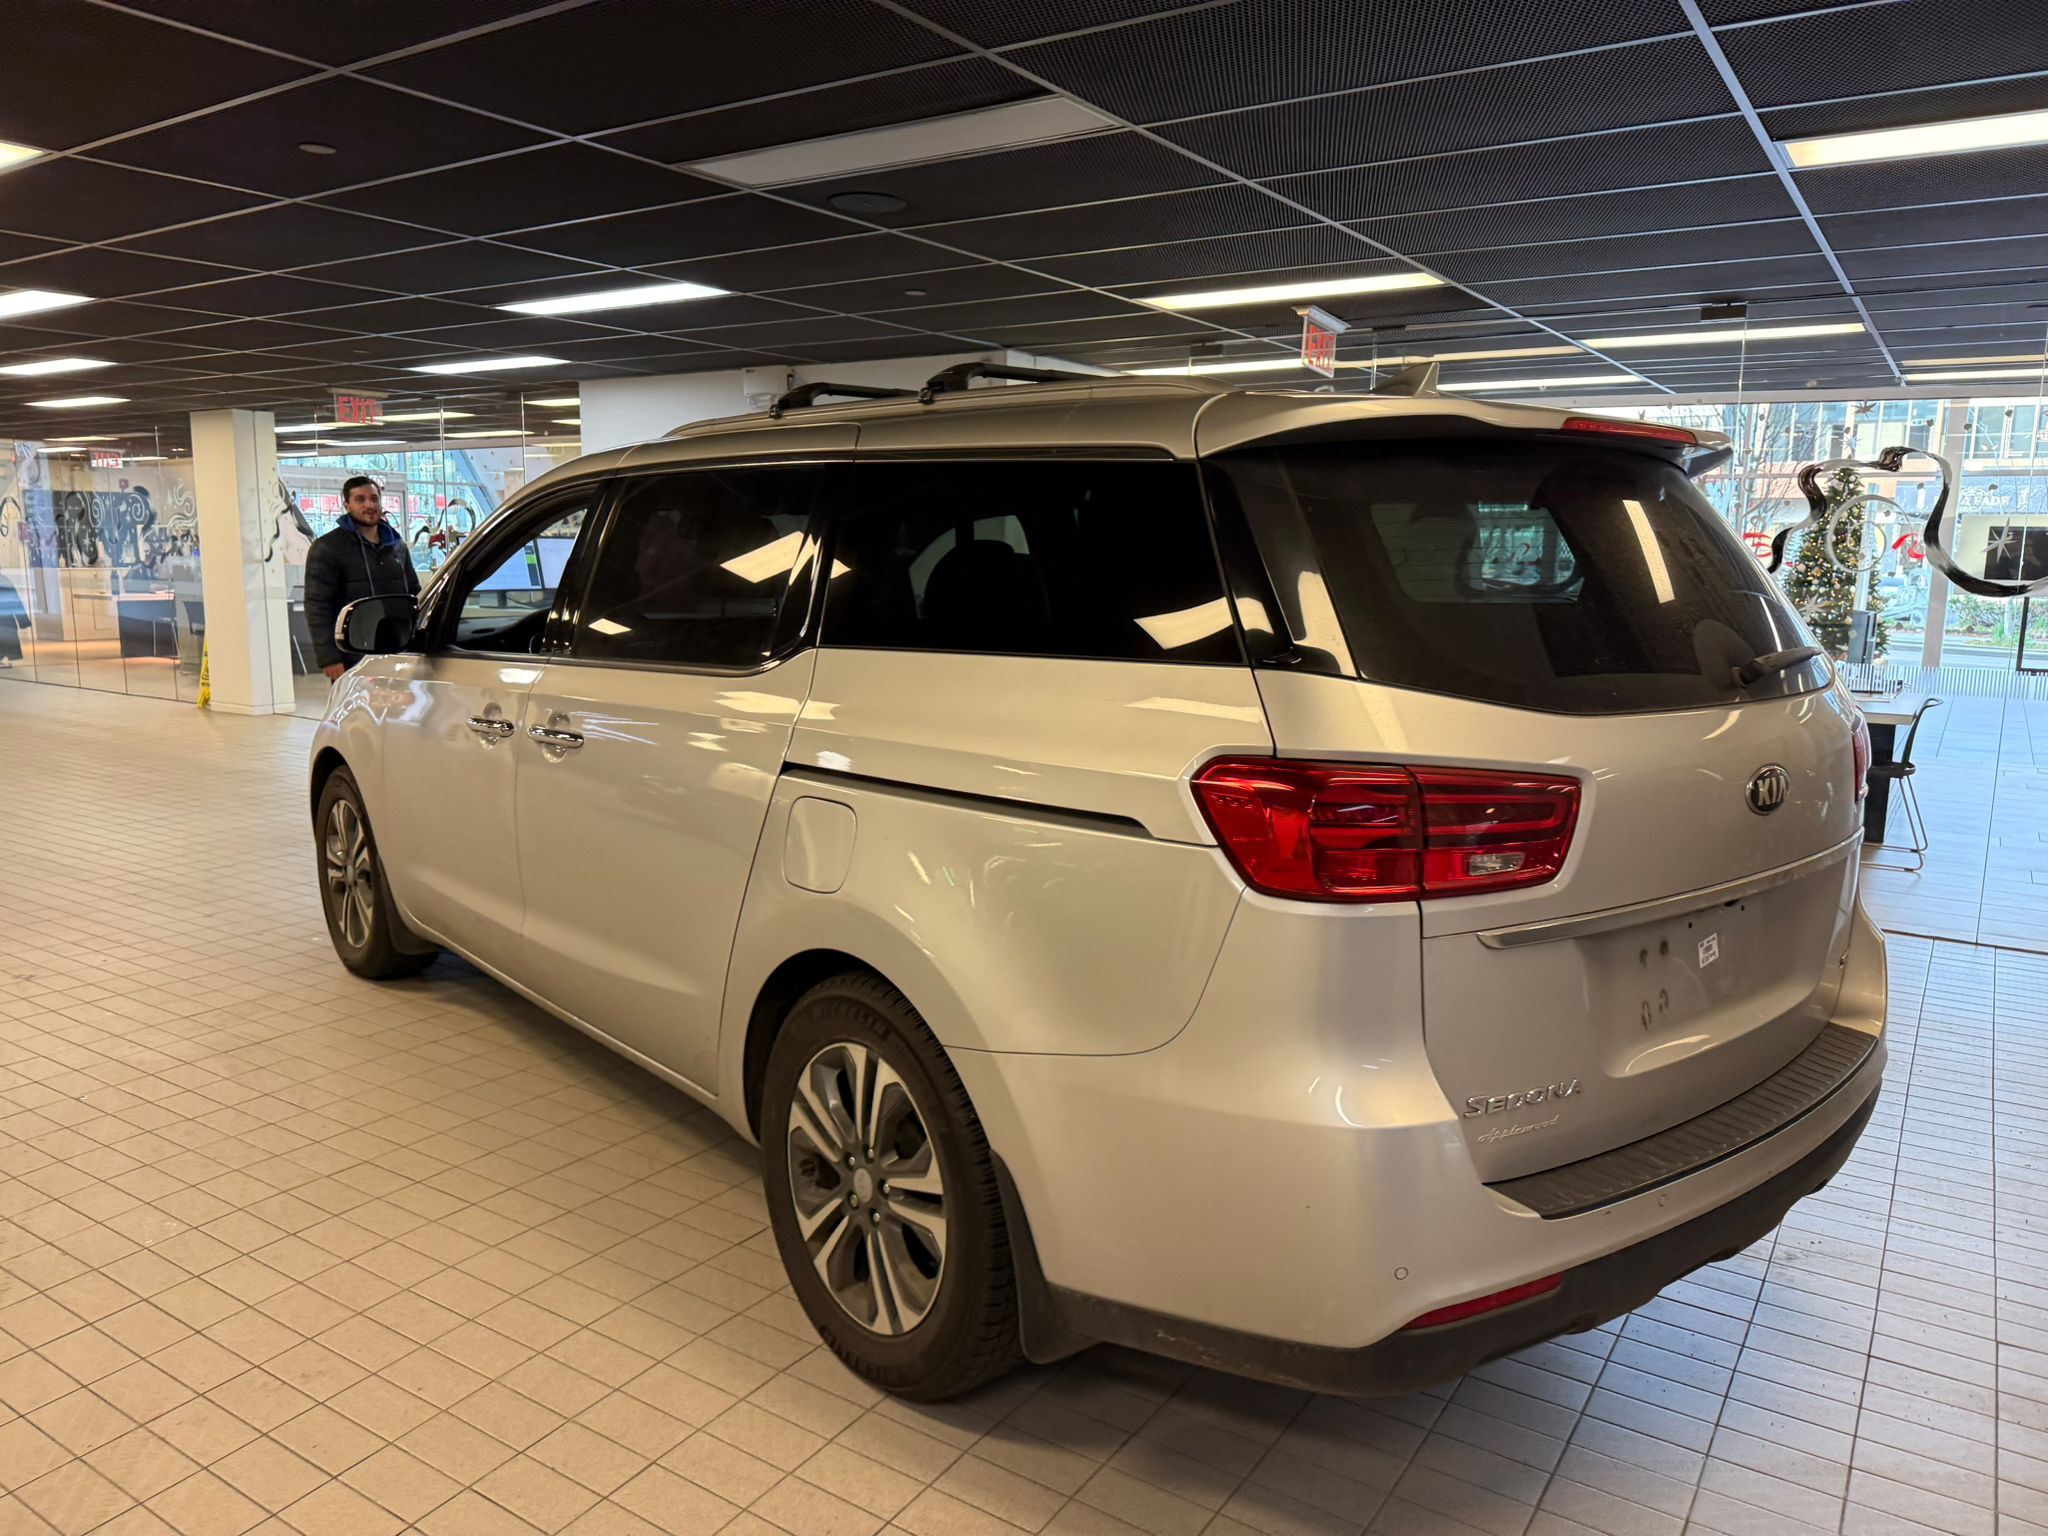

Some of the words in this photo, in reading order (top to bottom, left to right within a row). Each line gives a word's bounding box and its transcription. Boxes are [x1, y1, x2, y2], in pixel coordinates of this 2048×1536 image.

[338, 396, 376, 424] EXIT
[1756, 775, 1787, 806] KIA
[1463, 1078, 1584, 1118] SEDONA
